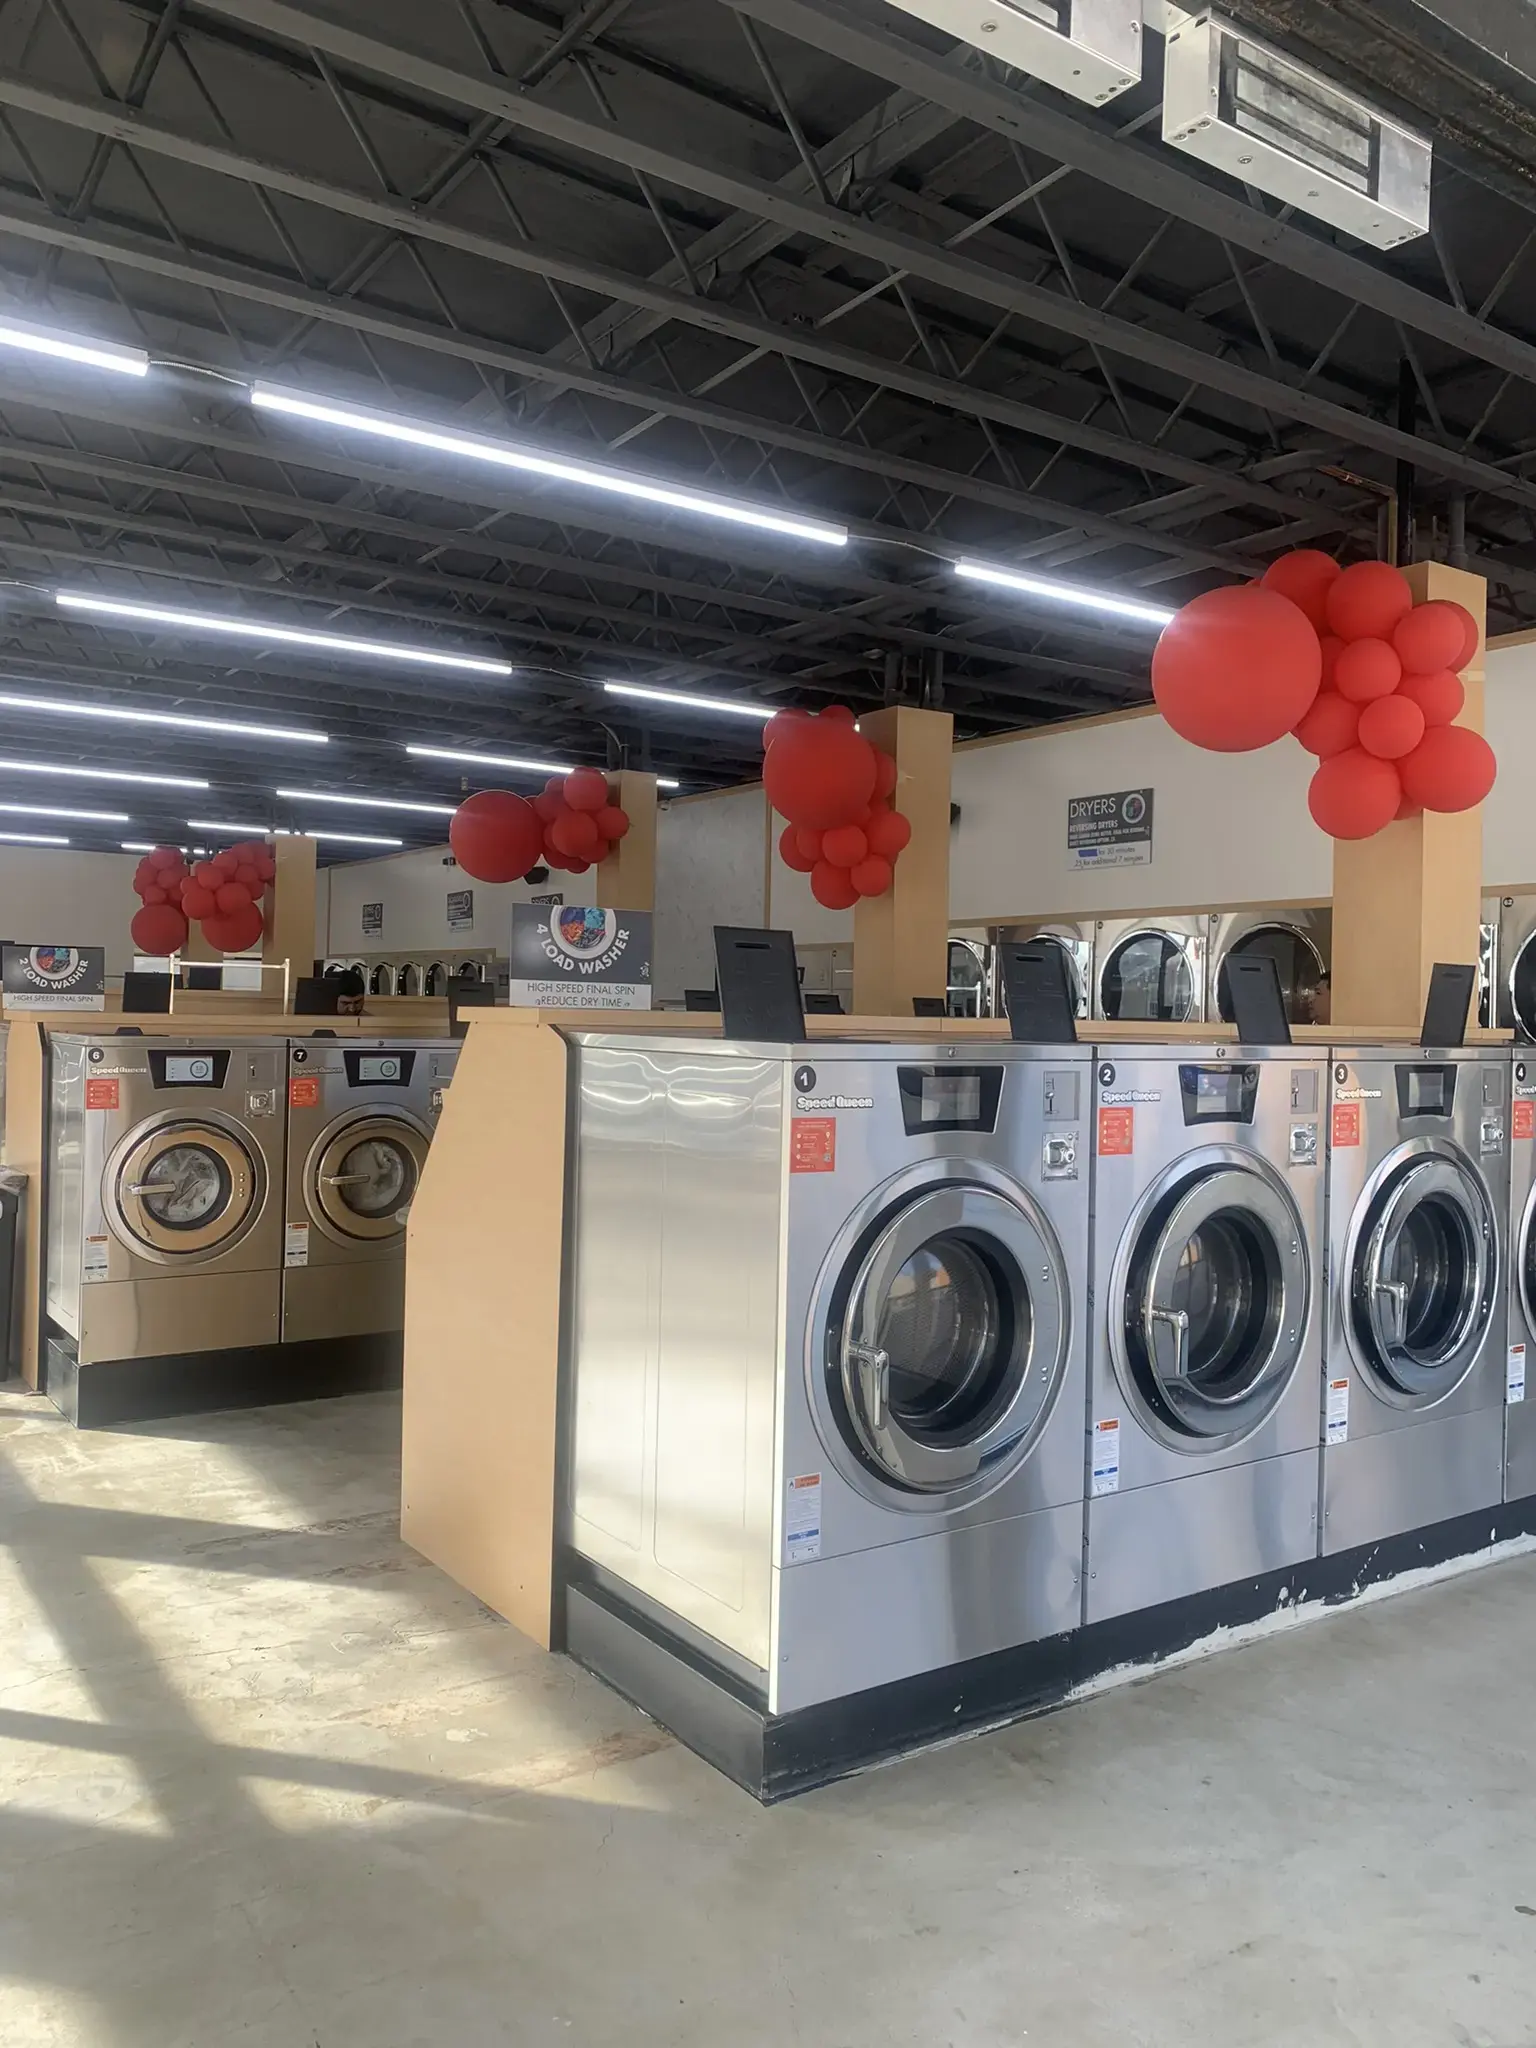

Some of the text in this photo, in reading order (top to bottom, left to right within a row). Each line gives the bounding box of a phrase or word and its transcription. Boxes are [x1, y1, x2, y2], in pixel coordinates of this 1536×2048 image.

[1070, 797, 1116, 818] DRYERS
[536, 923, 548, 934] 4
[540, 938, 575, 971] LOAD
[578, 928, 630, 974] WASHER
[23, 966, 48, 988] LOAD
[50, 960, 89, 990] WASHER
[527, 982, 635, 995] HIGH SPEED FINAL SPIN
[541, 996, 622, 1007] REDUCE DRY TIME
[92, 1051, 100, 1059] 6
[90, 1066, 119, 1076] Speed
[1103, 1069, 1111, 1081] 2
[1338, 1068, 1344, 1080] 3
[1518, 1067, 1523, 1077] 4
[800, 1072, 808, 1086] 1
[1102, 1089, 1161, 1104] Speed Queen
[796, 1095, 873, 1112] Speed Queen
